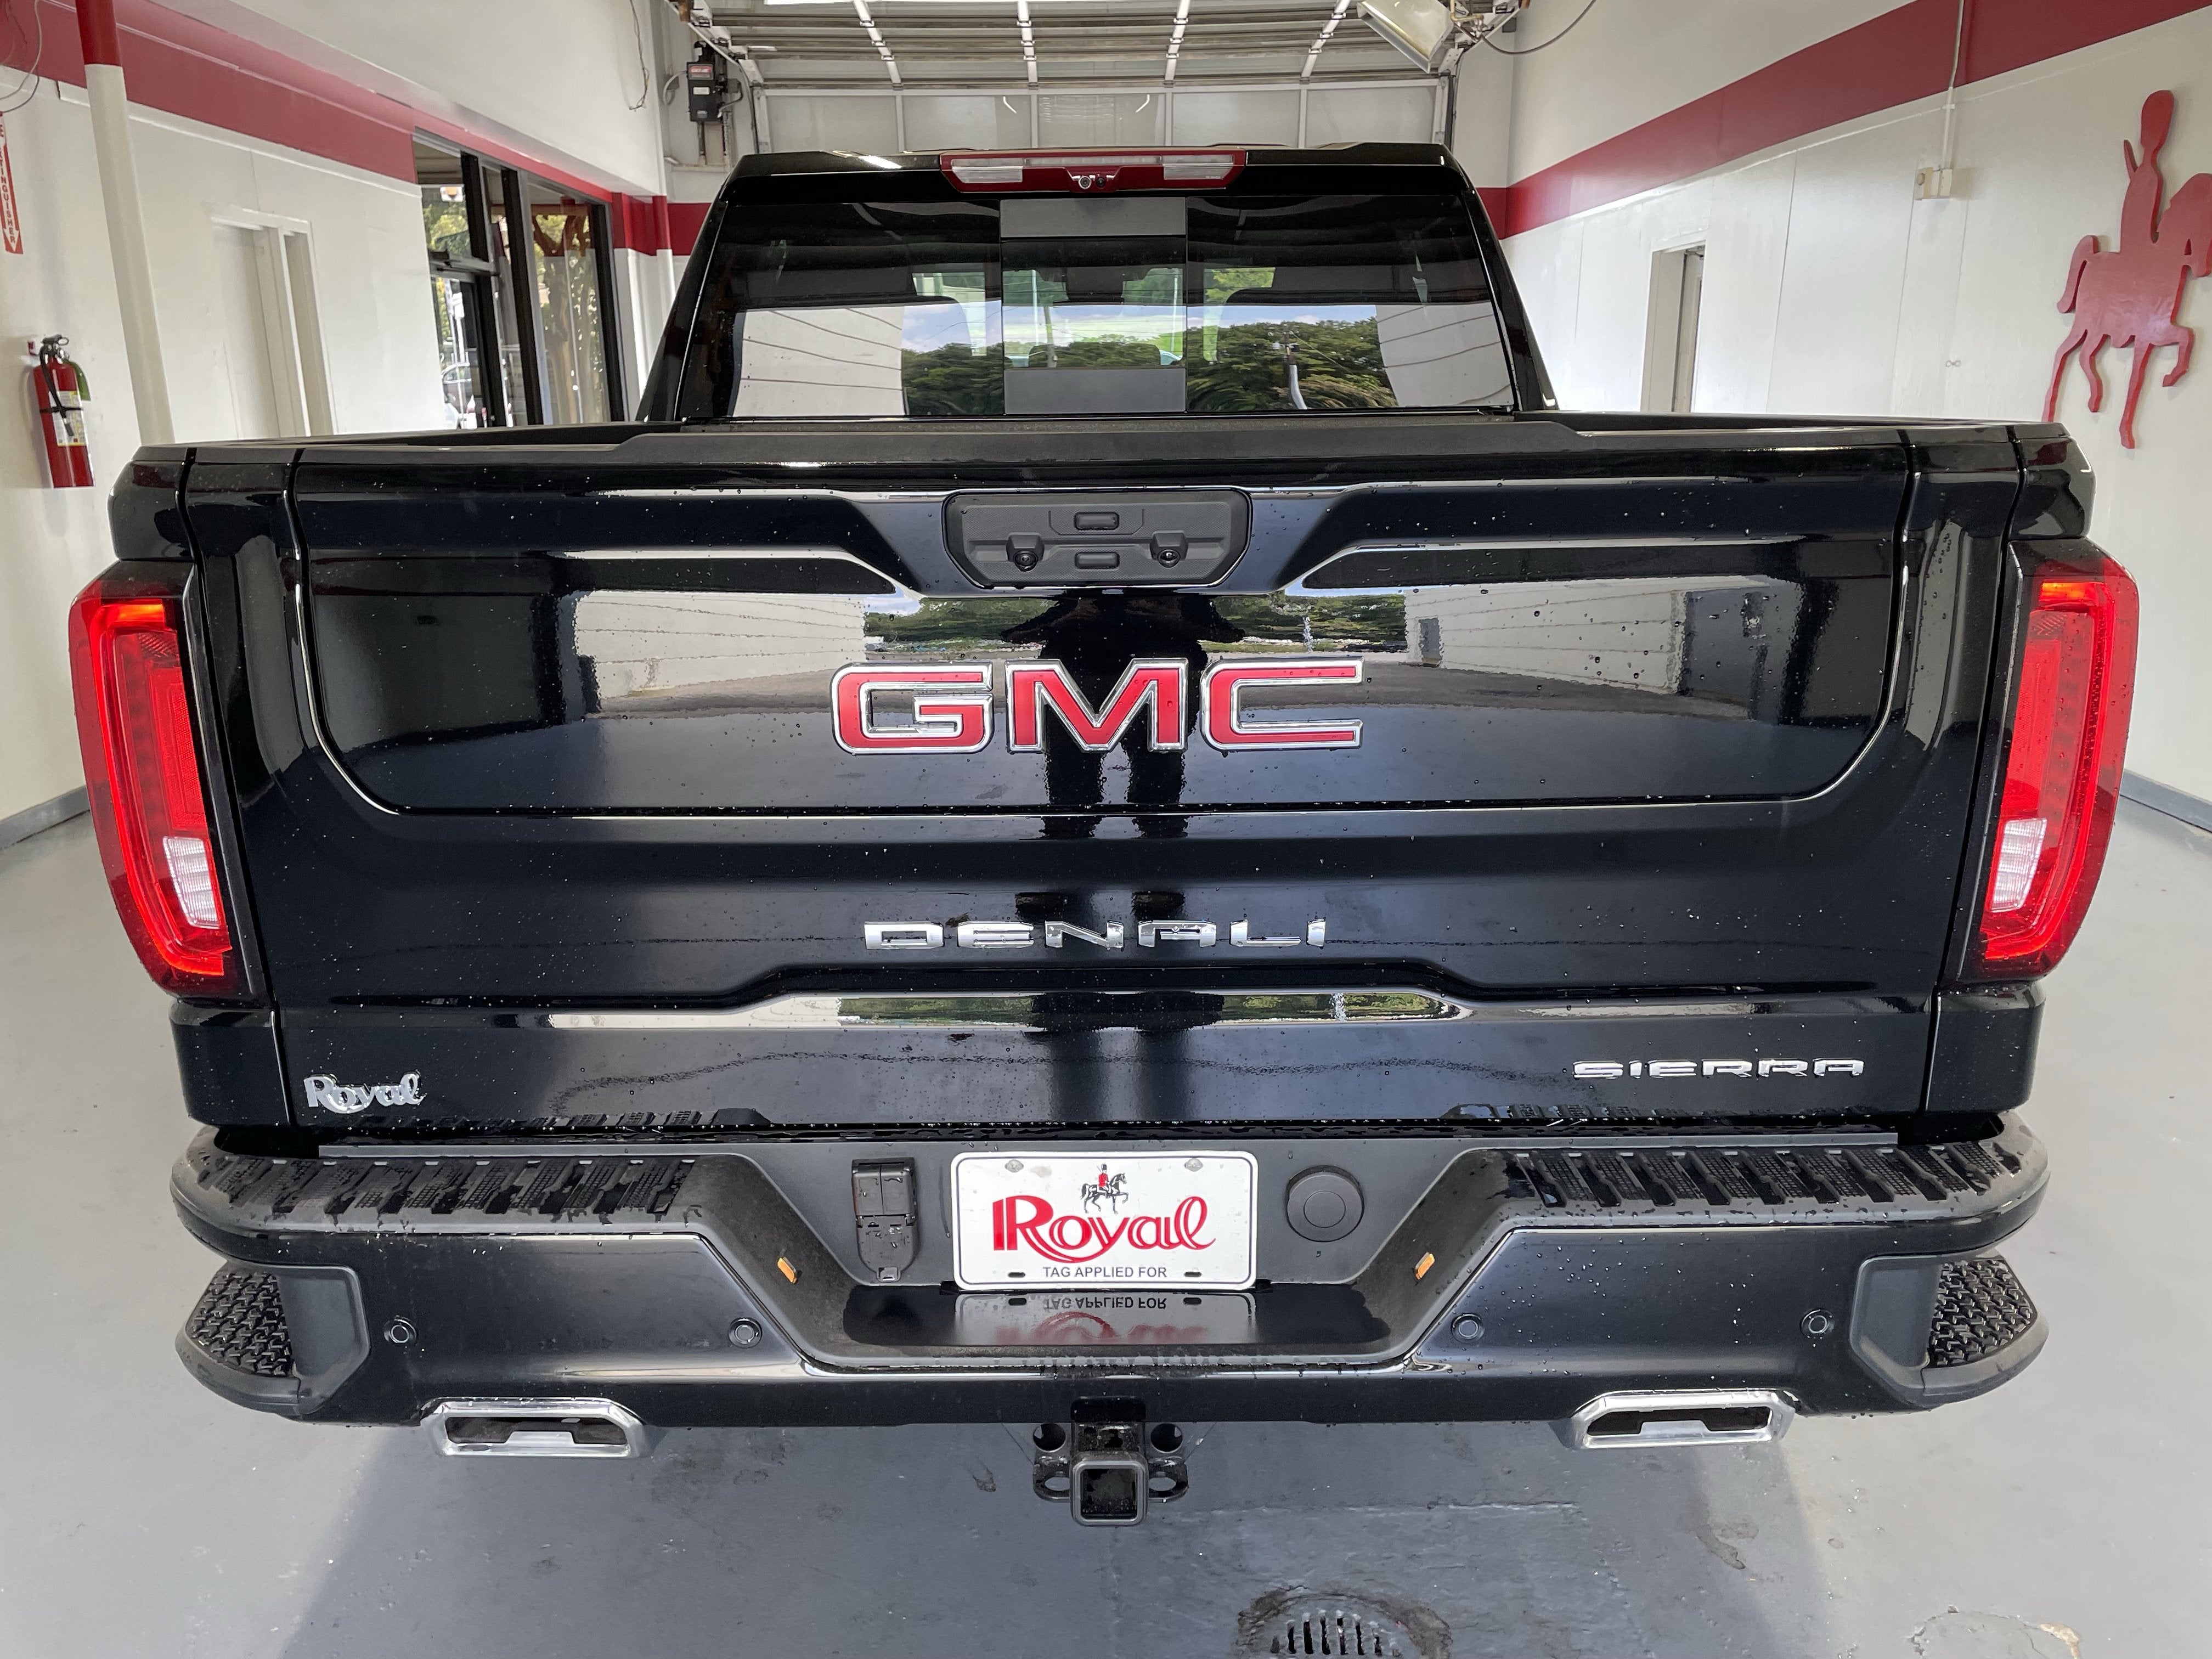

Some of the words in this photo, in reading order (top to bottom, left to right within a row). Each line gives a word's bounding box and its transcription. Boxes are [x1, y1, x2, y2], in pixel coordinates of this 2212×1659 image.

[0, 147, 15, 243] XTINGUISHER
[832, 658, 1365, 754] GMC
[865, 919, 1327, 950] DENALI
[1573, 1058, 1864, 1079] SIERRA
[303, 1073, 426, 1114] Royal
[992, 1195, 1216, 1263] Royal
[1043, 1267, 1071, 1278] TAG
[1075, 1266, 1134, 1278] APPLIED
[1138, 1267, 1167, 1278] FOR
